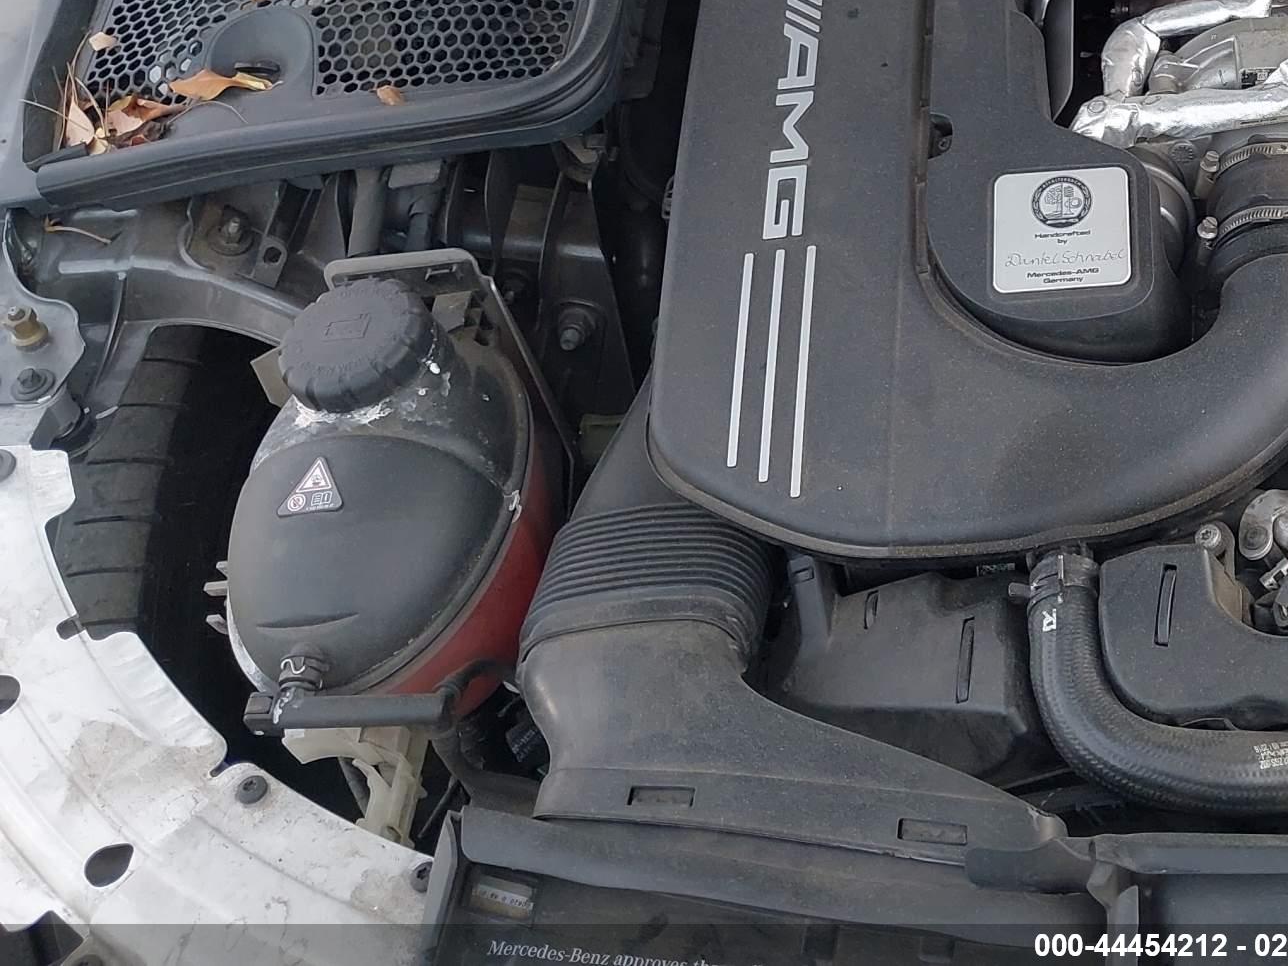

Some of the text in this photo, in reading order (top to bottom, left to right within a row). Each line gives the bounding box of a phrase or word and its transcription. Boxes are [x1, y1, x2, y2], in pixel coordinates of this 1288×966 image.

[762, 22, 819, 240] AMG
[1034, 230, 1091, 239] Handcrafted
[1026, 267, 1100, 279] Mercedes-AMG
[1042, 276, 1084, 285] Germany
[487, 939, 611, 966] Mercedes-Benz
